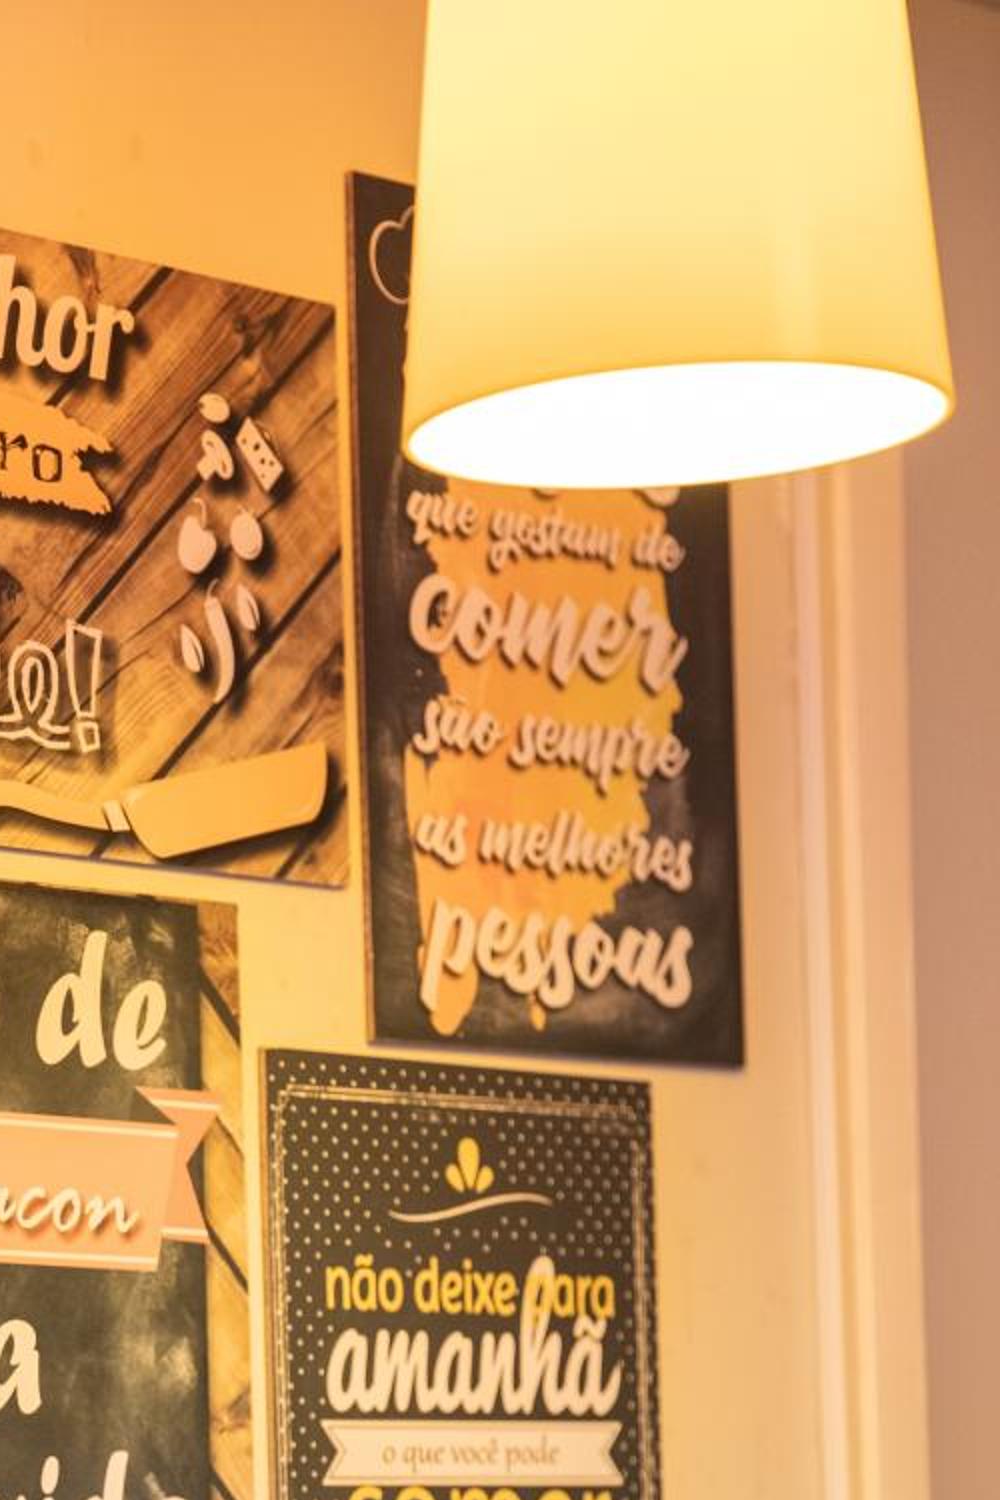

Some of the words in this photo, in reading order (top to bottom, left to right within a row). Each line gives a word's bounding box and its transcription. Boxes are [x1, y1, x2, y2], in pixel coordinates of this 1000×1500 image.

[406, 490, 480, 544] que
[490, 508, 622, 570] gostam
[631, 522, 687, 572] de
[412, 694, 503, 753] são
[509, 714, 691, 793] sempre
[417, 814, 467, 865] as
[481, 810, 693, 891] melhores
[420, 898, 694, 1008] pessoas
[35, 929, 168, 1071] de
[325, 1253, 403, 1313] não
[414, 1257, 517, 1316] deixe
[326, 1255, 625, 1416] amanhã
[381, 1445, 397, 1465] o
[402, 1446, 443, 1473] que
[450, 1436, 498, 1464] você
[503, 1434, 561, 1473] pode
